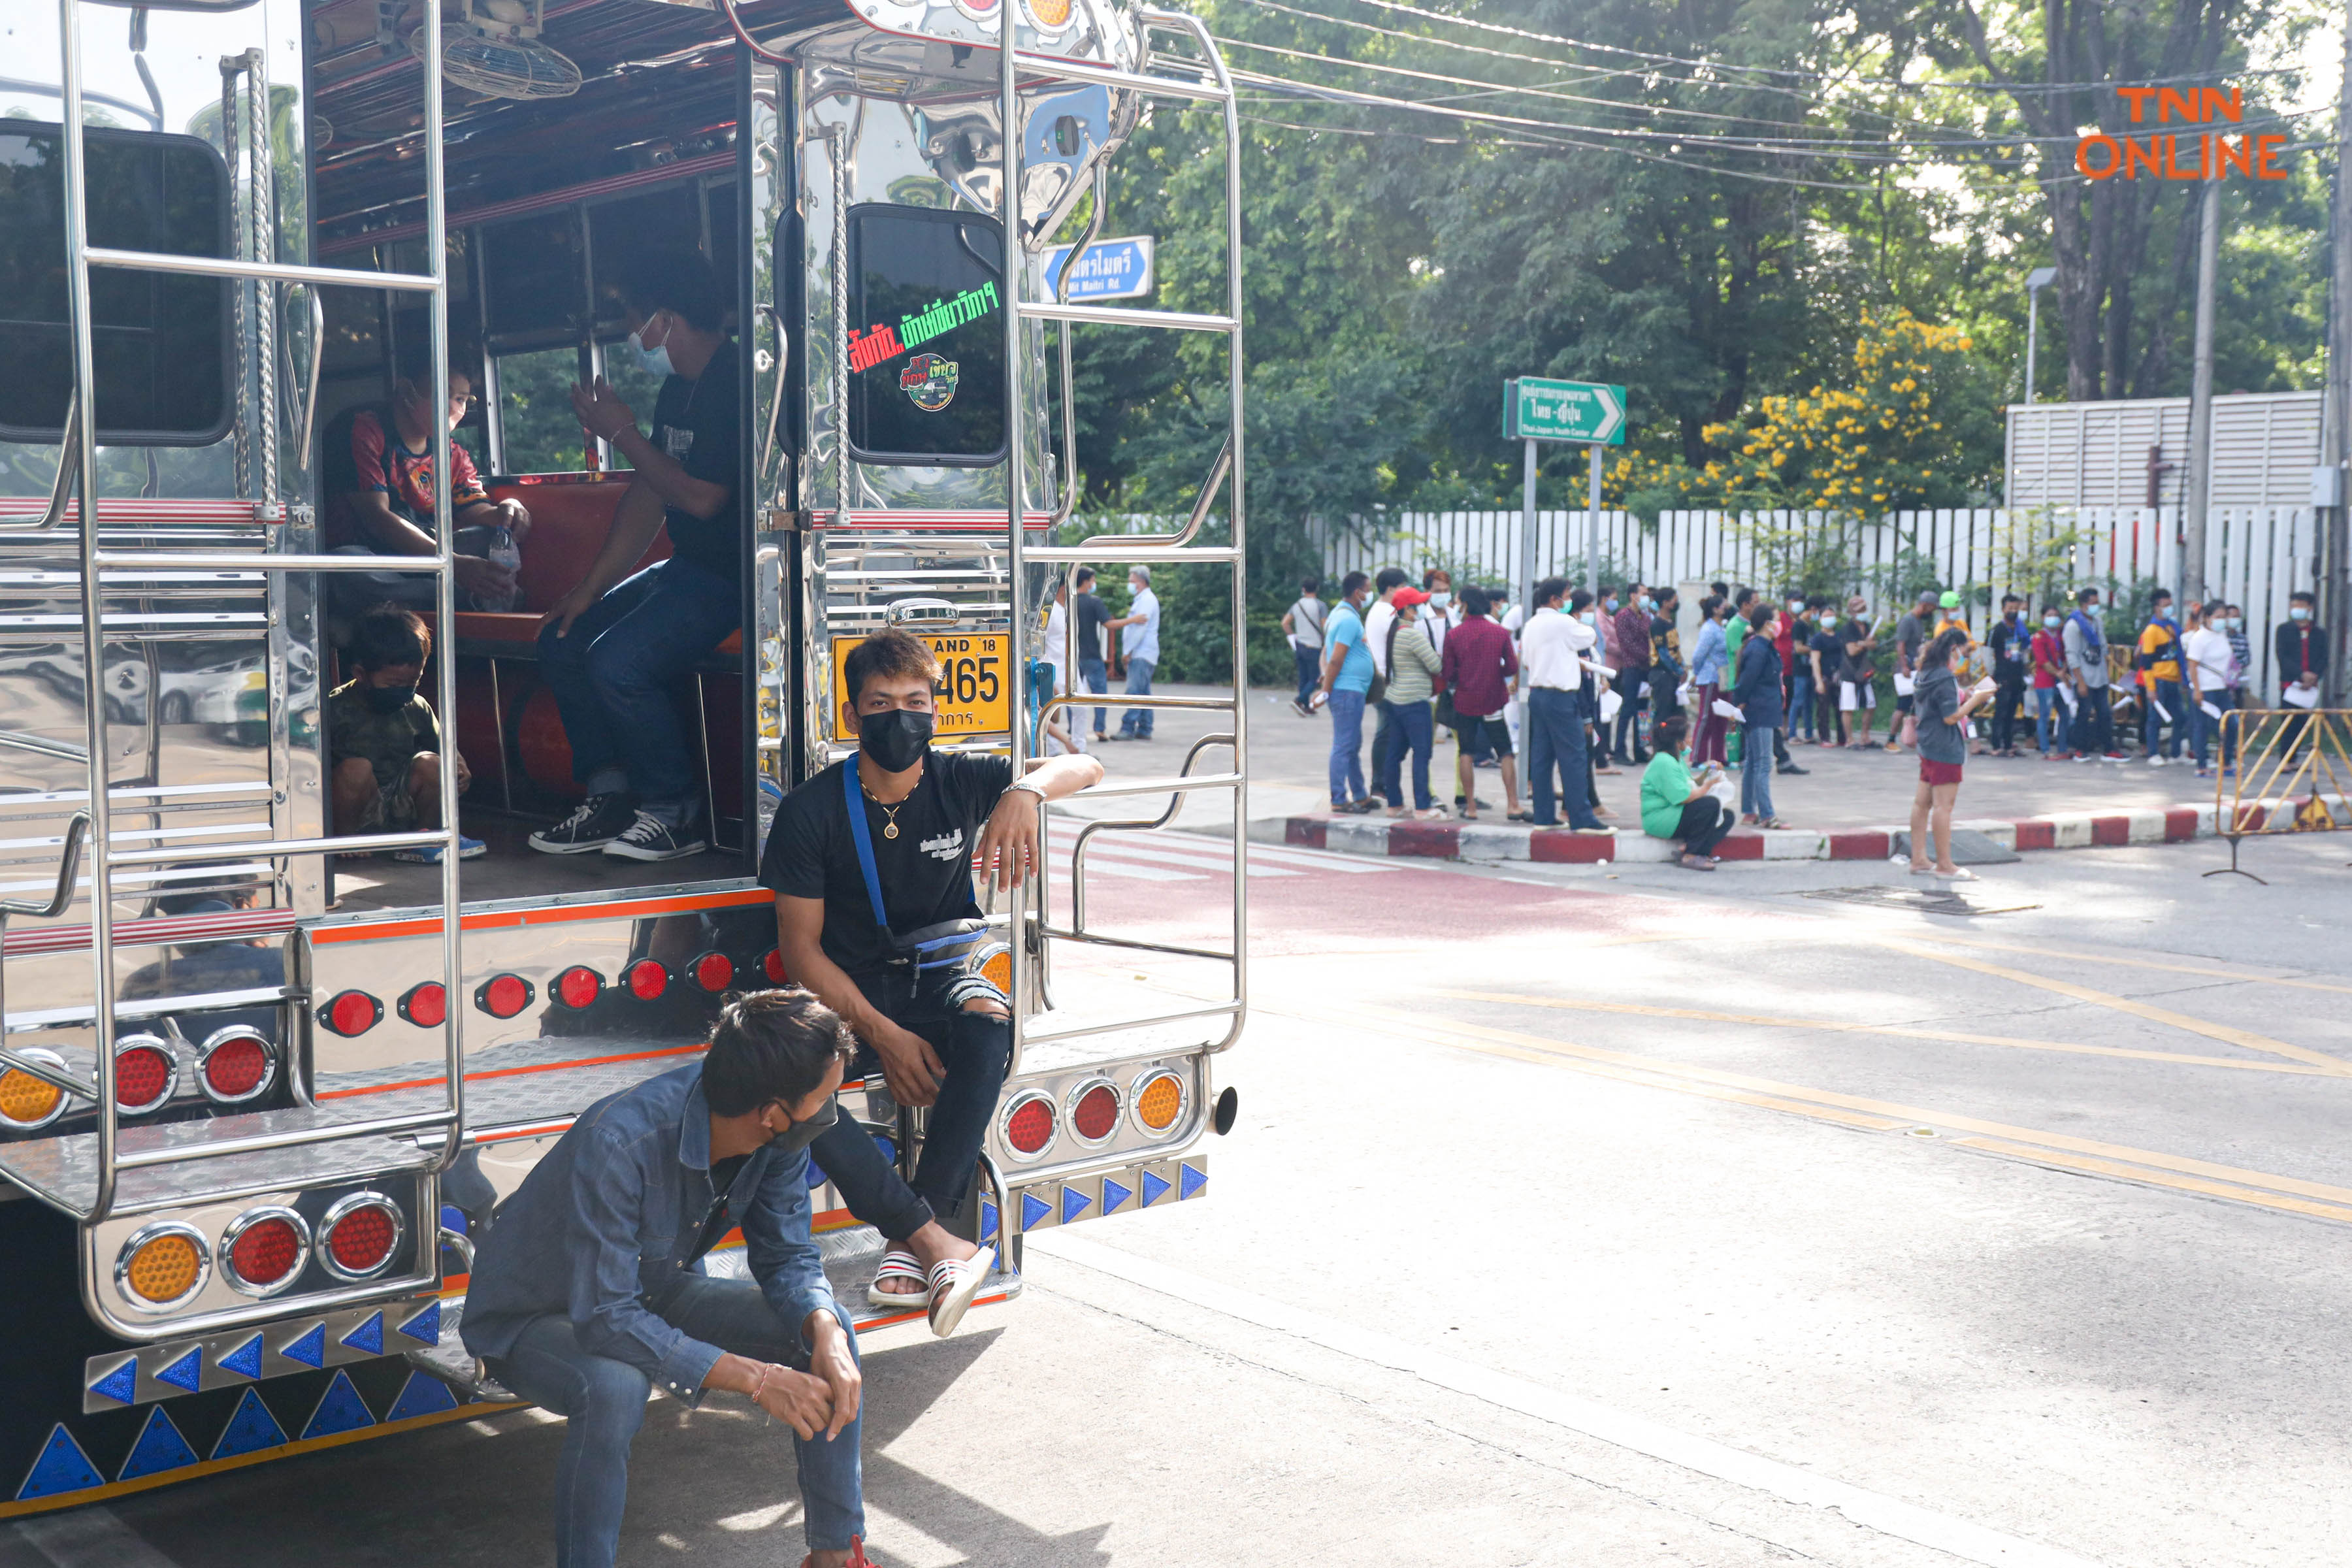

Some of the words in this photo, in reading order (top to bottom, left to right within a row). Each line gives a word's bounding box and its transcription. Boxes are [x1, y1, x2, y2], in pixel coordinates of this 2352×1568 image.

[1082, 280, 1104, 292] Maitri
[1108, 278, 1120, 290] Rd.
[923, 640, 970, 653] AND
[934, 656, 1000, 705] 465
[937, 711, 973, 727] าการ
